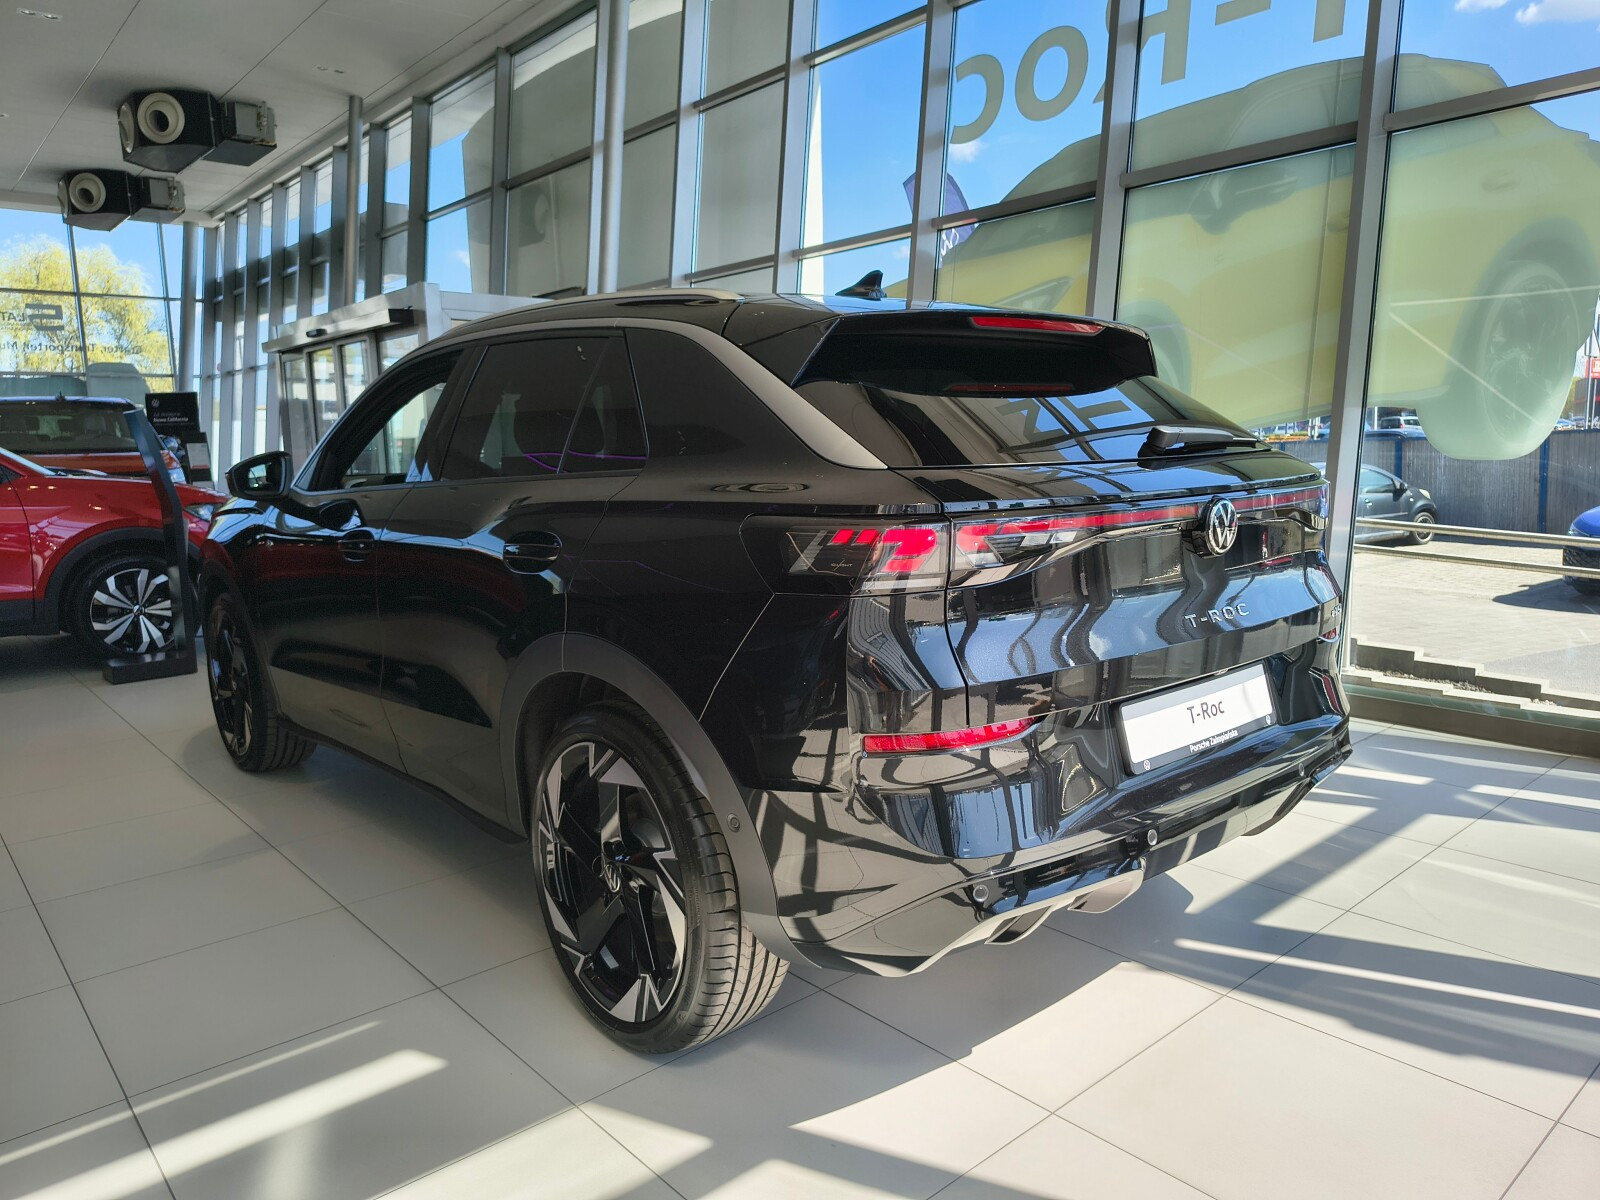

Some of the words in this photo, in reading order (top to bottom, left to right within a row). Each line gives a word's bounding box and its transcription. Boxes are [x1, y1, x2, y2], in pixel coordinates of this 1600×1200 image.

[1185, 603, 1250, 628] T-ROC
[1187, 700, 1225, 724] T-Roc
[1189, 739, 1210, 753] Porsche
